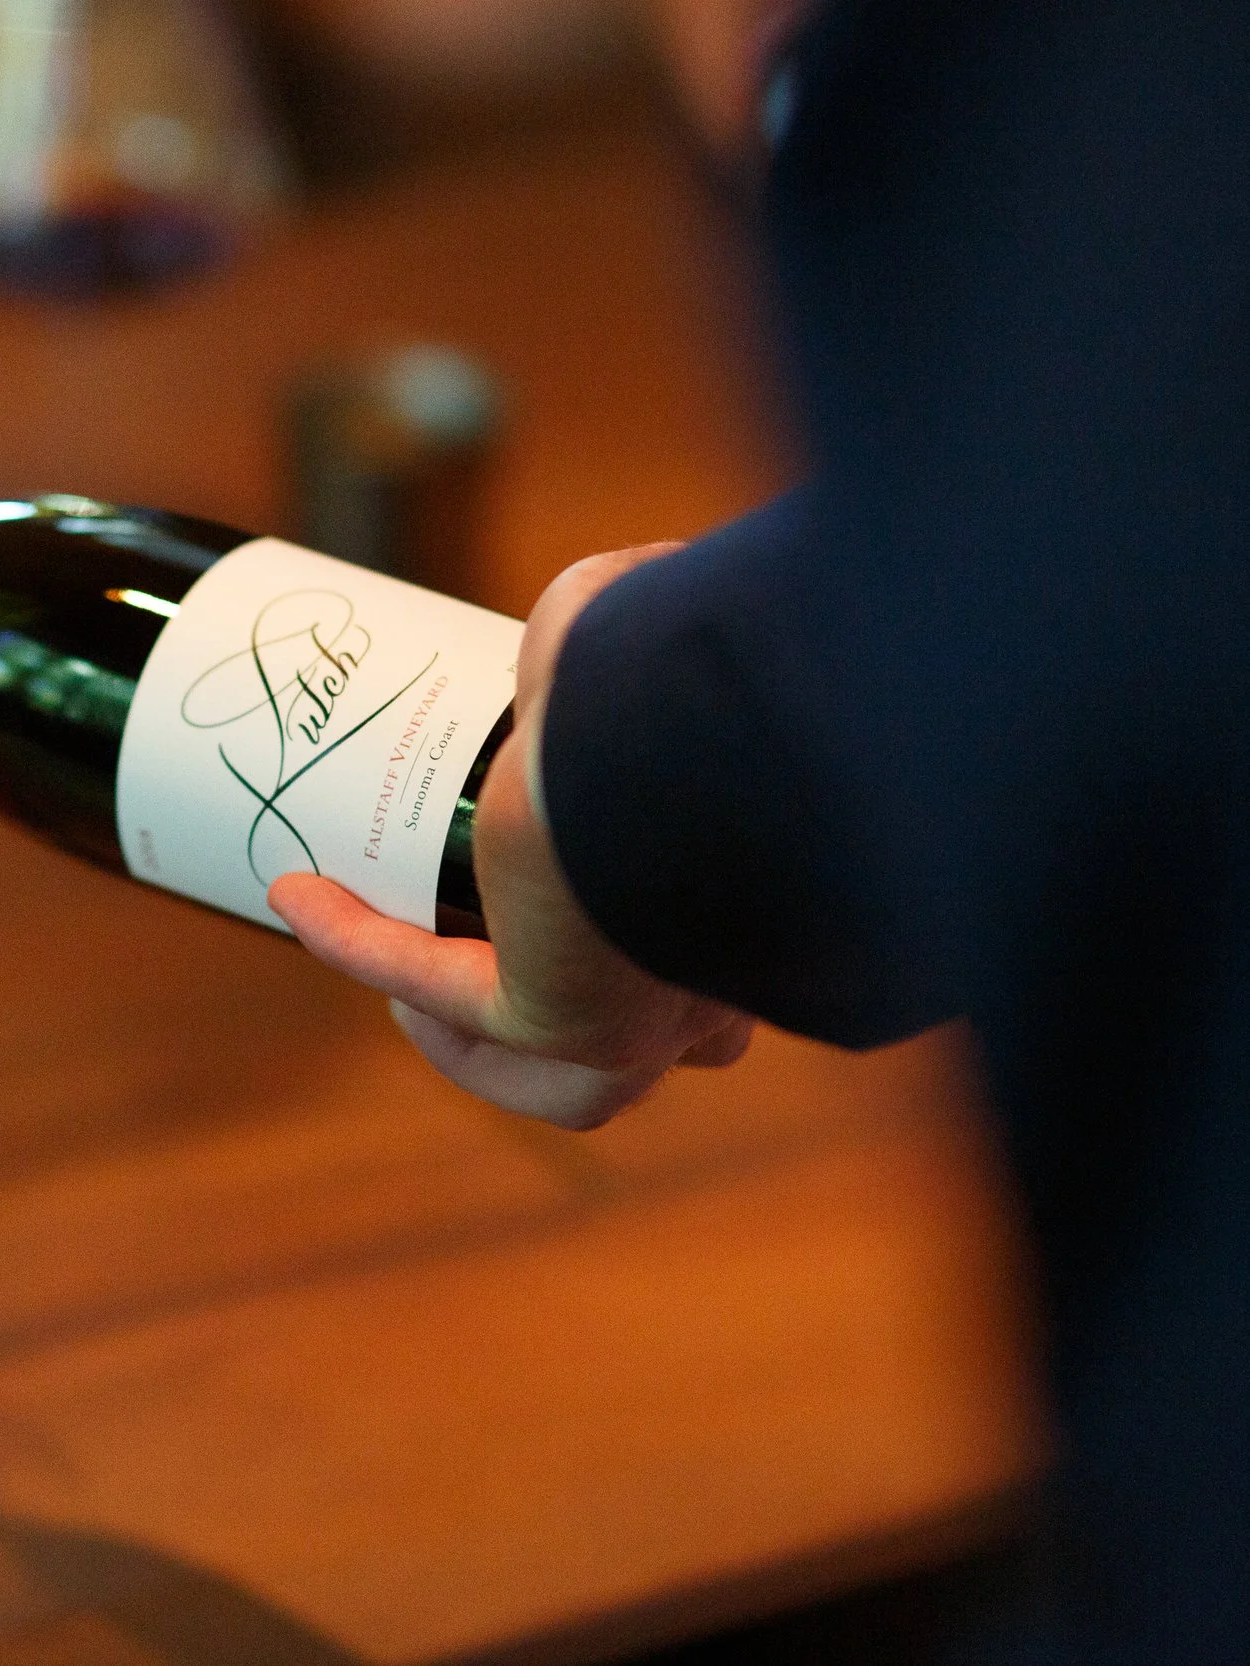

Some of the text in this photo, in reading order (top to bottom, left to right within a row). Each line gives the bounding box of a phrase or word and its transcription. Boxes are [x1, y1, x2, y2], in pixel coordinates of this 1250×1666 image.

[364, 675, 448, 861] FALSTAFF VINEYARD
[404, 719, 459, 831] Sonoma Coast
